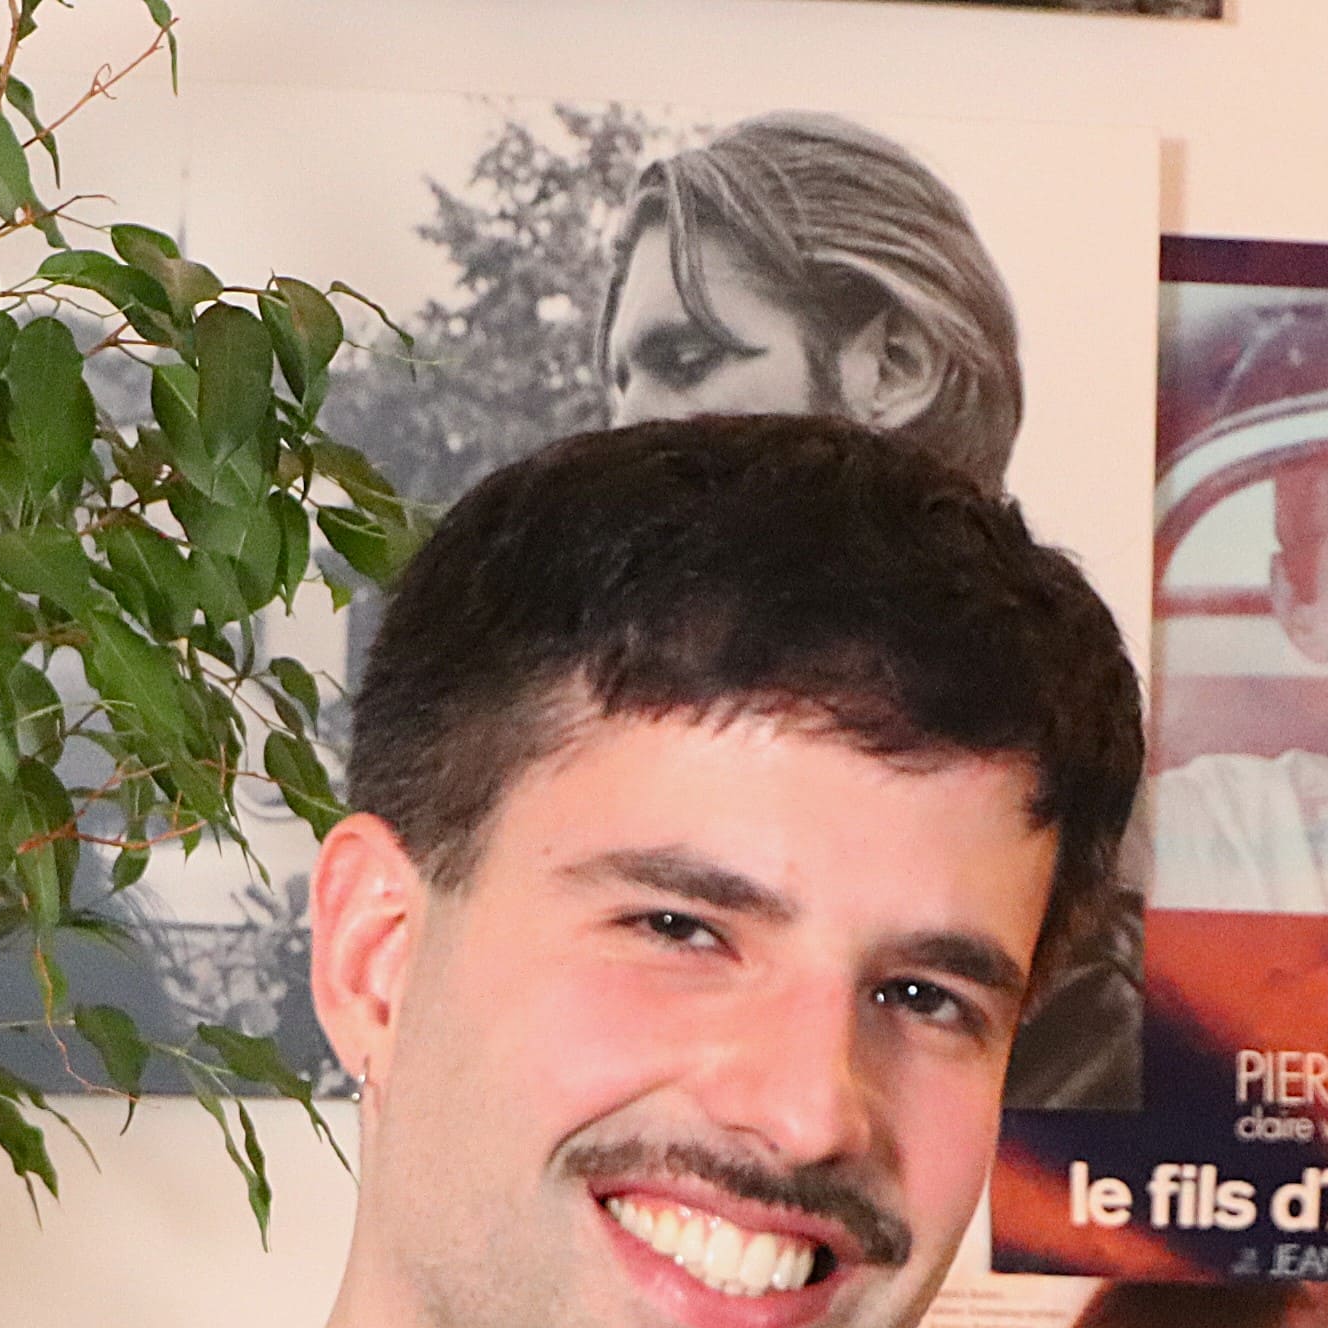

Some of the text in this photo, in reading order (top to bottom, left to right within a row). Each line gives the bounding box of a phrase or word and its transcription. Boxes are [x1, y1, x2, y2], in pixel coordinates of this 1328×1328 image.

[1235, 1104, 1315, 1141] claire
[1070, 1160, 1133, 1227] le
[1147, 1163, 1258, 1231] fils
